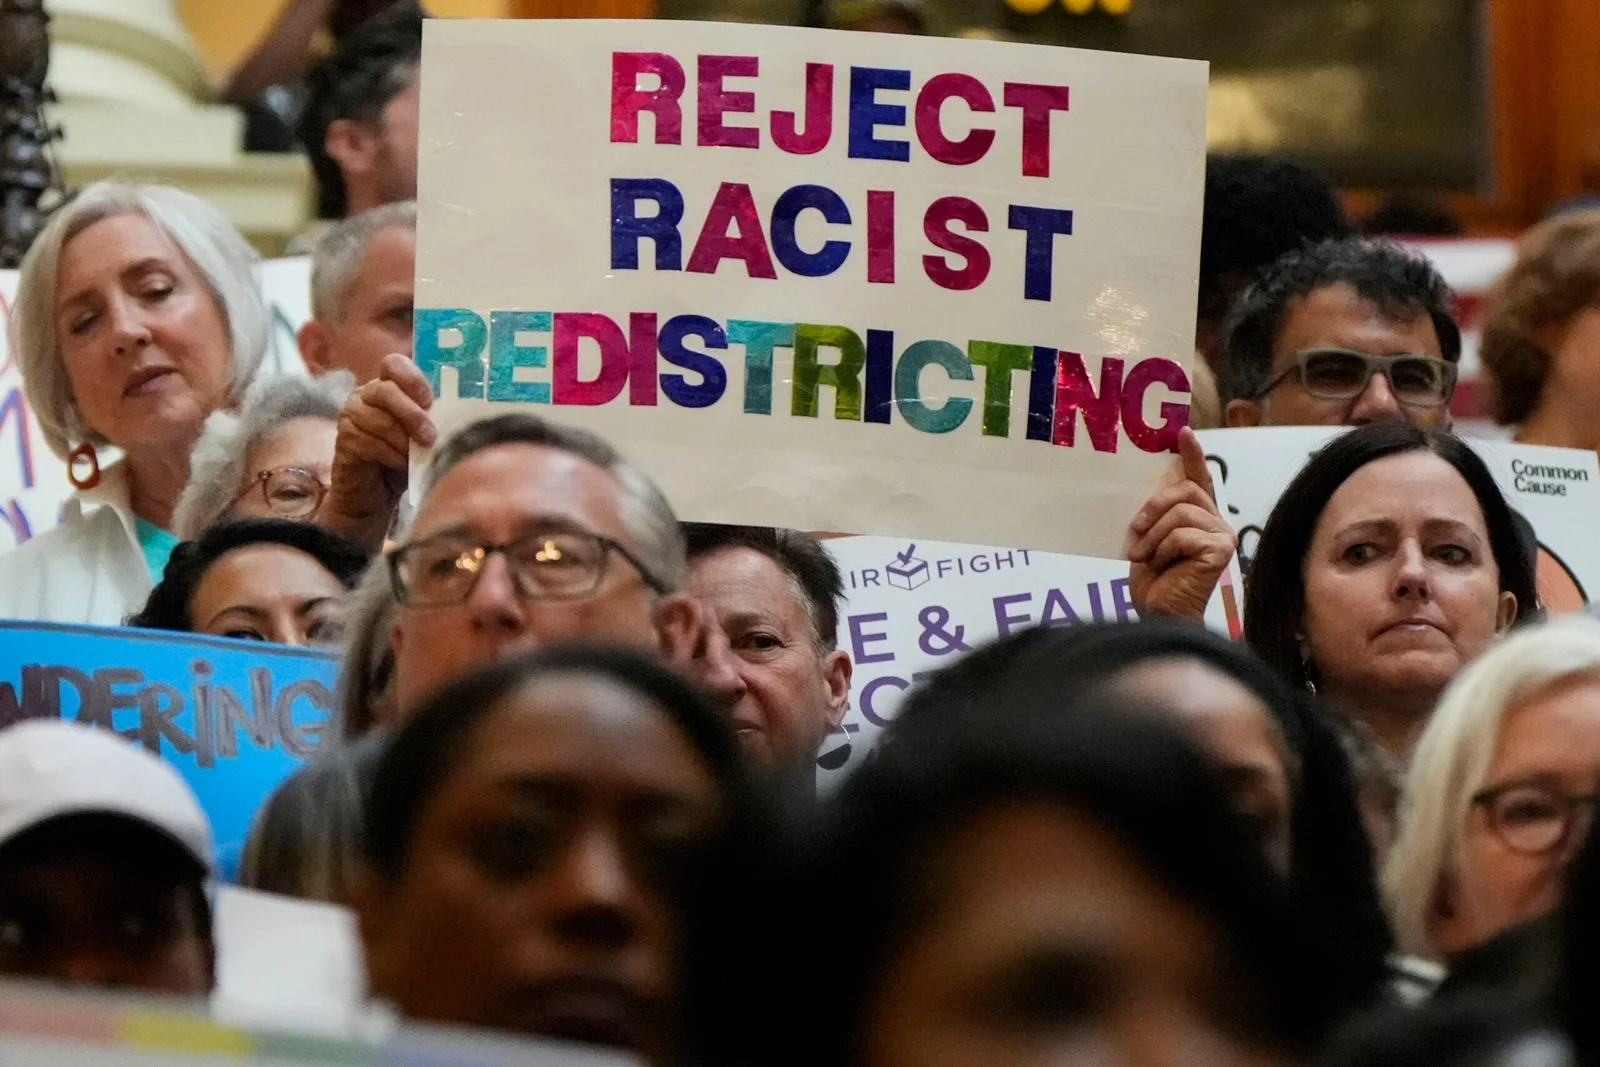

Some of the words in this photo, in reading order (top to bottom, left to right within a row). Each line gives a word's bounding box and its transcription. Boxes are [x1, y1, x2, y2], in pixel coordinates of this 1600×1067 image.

[610, 51, 1070, 178] REJECT
[610, 177, 1074, 302] RACIST
[413, 307, 1192, 454] REDISTRICTING
[1511, 458, 1589, 481] Common
[1514, 475, 1567, 497] Cause
[936, 548, 1031, 579] FIGHT
[918, 605, 974, 656] &
